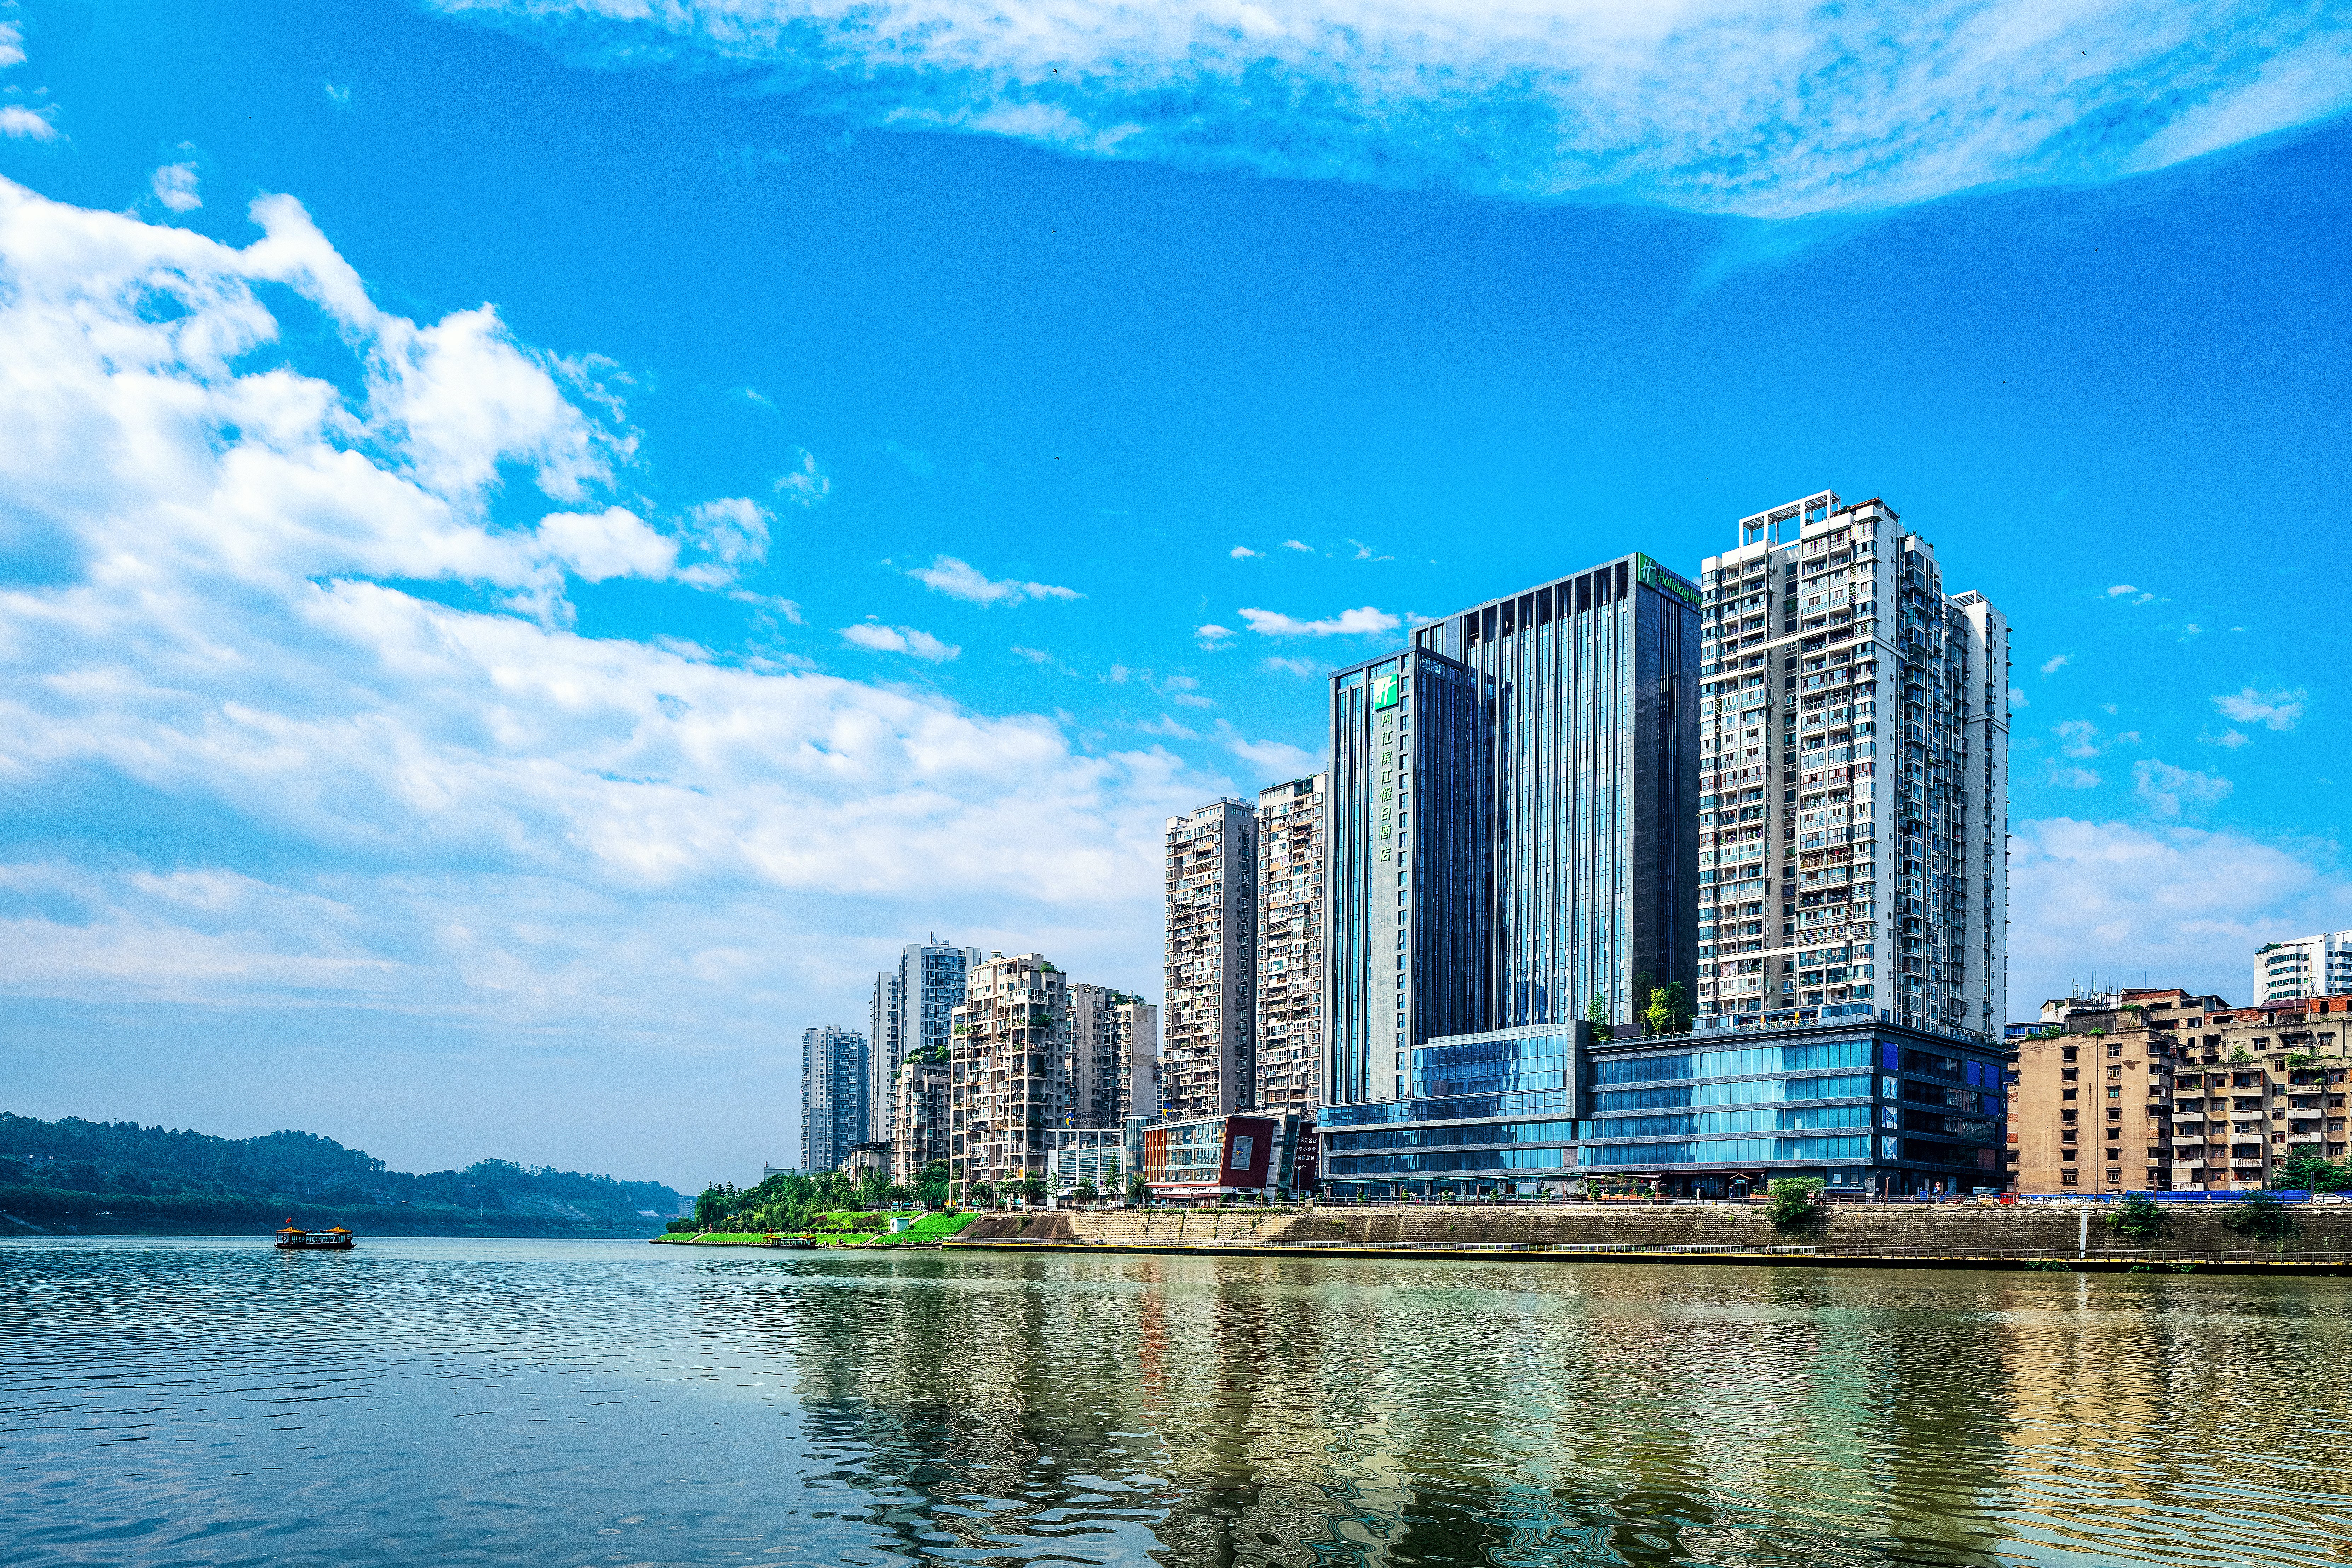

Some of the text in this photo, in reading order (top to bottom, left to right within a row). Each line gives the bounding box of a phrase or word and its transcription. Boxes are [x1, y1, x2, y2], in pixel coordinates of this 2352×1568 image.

[1658, 569, 1702, 606] Holiday Inn
[1379, 711, 1393, 862] 内江滨江假日酒店
